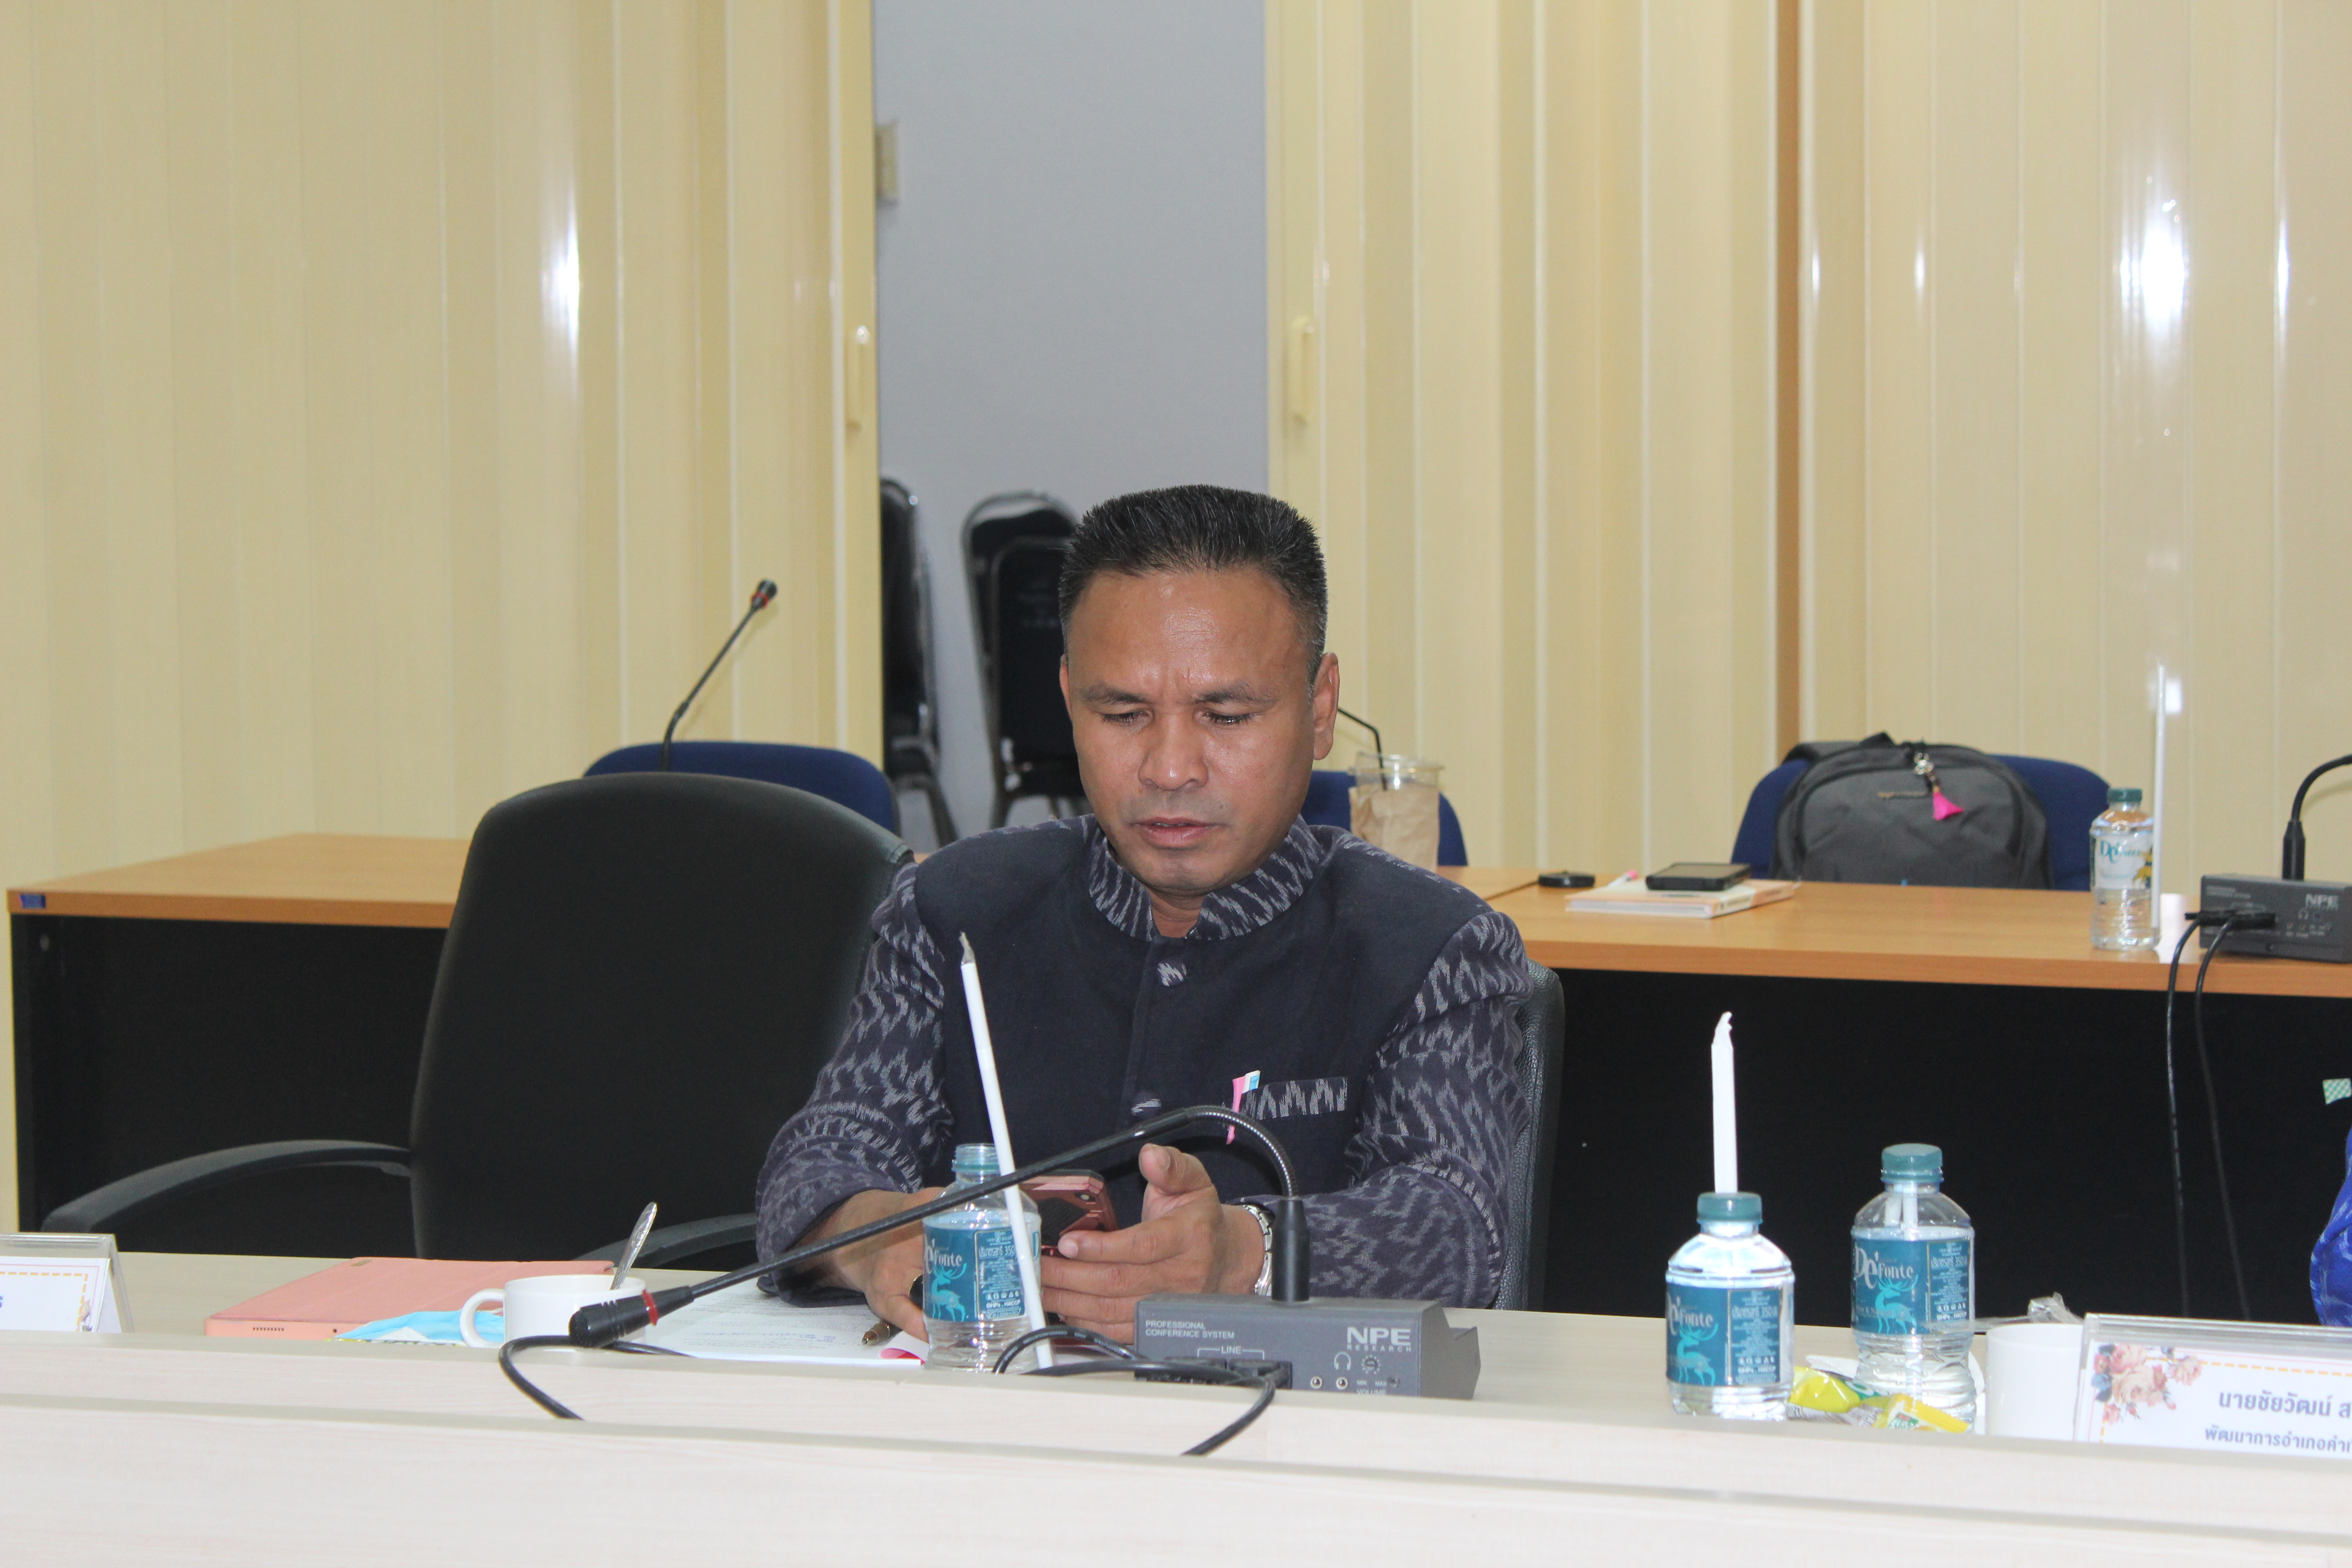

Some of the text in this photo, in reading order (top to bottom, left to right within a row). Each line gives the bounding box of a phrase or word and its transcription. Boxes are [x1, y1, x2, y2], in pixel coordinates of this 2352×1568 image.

[2306, 893, 2338, 910] NPE
[1145, 1320, 1205, 1329] PROFESSIONAL
[1145, 1328, 1235, 1339] CONFERENCE SYSTEM
[1347, 1326, 1411, 1346] NPE
[1221, 1346, 1241, 1355] LINE
[1347, 1344, 1411, 1352] RESEARCH
[2219, 1390, 2333, 1416] นายชัยวัฒน์
